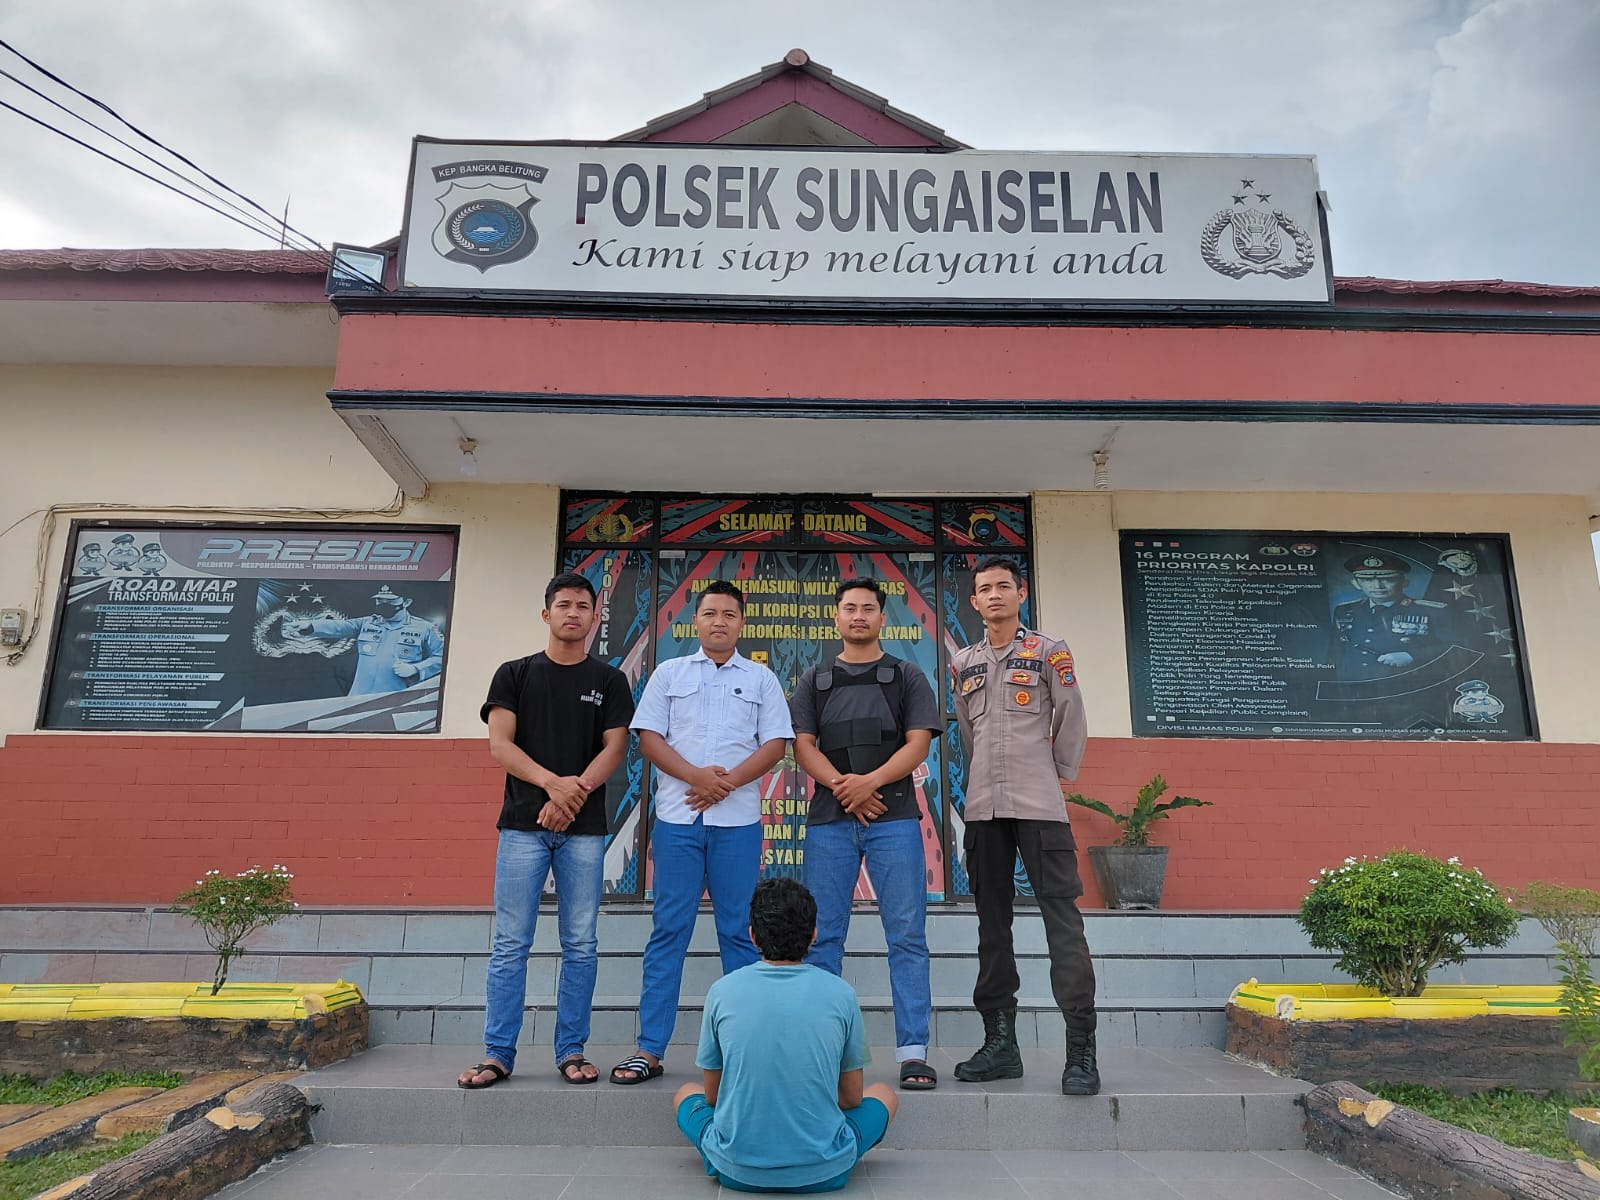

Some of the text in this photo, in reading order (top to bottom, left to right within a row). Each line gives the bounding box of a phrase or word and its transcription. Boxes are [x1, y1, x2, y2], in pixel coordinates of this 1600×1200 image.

[460, 164, 496, 173] BANGKA
[499, 165, 540, 178] BELITUNG
[575, 163, 1163, 234] POLSEK SUNGAISELAN
[572, 238, 1167, 285] Kami siap melayani anda
[719, 513, 867, 532] SELAMAT DATANG
[198, 538, 430, 562] PRESISI
[109, 579, 237, 591] ROAD MAP
[108, 592, 234, 602] TRANSFORMASI POLRI
[599, 558, 612, 656] POLSEK
[763, 603, 820, 618] KORUPSI
[740, 624, 806, 639] IROKRASI
[809, 625, 842, 640] BERS
[1008, 660, 1042, 672] POLRI
[764, 824, 792, 840] DAN
